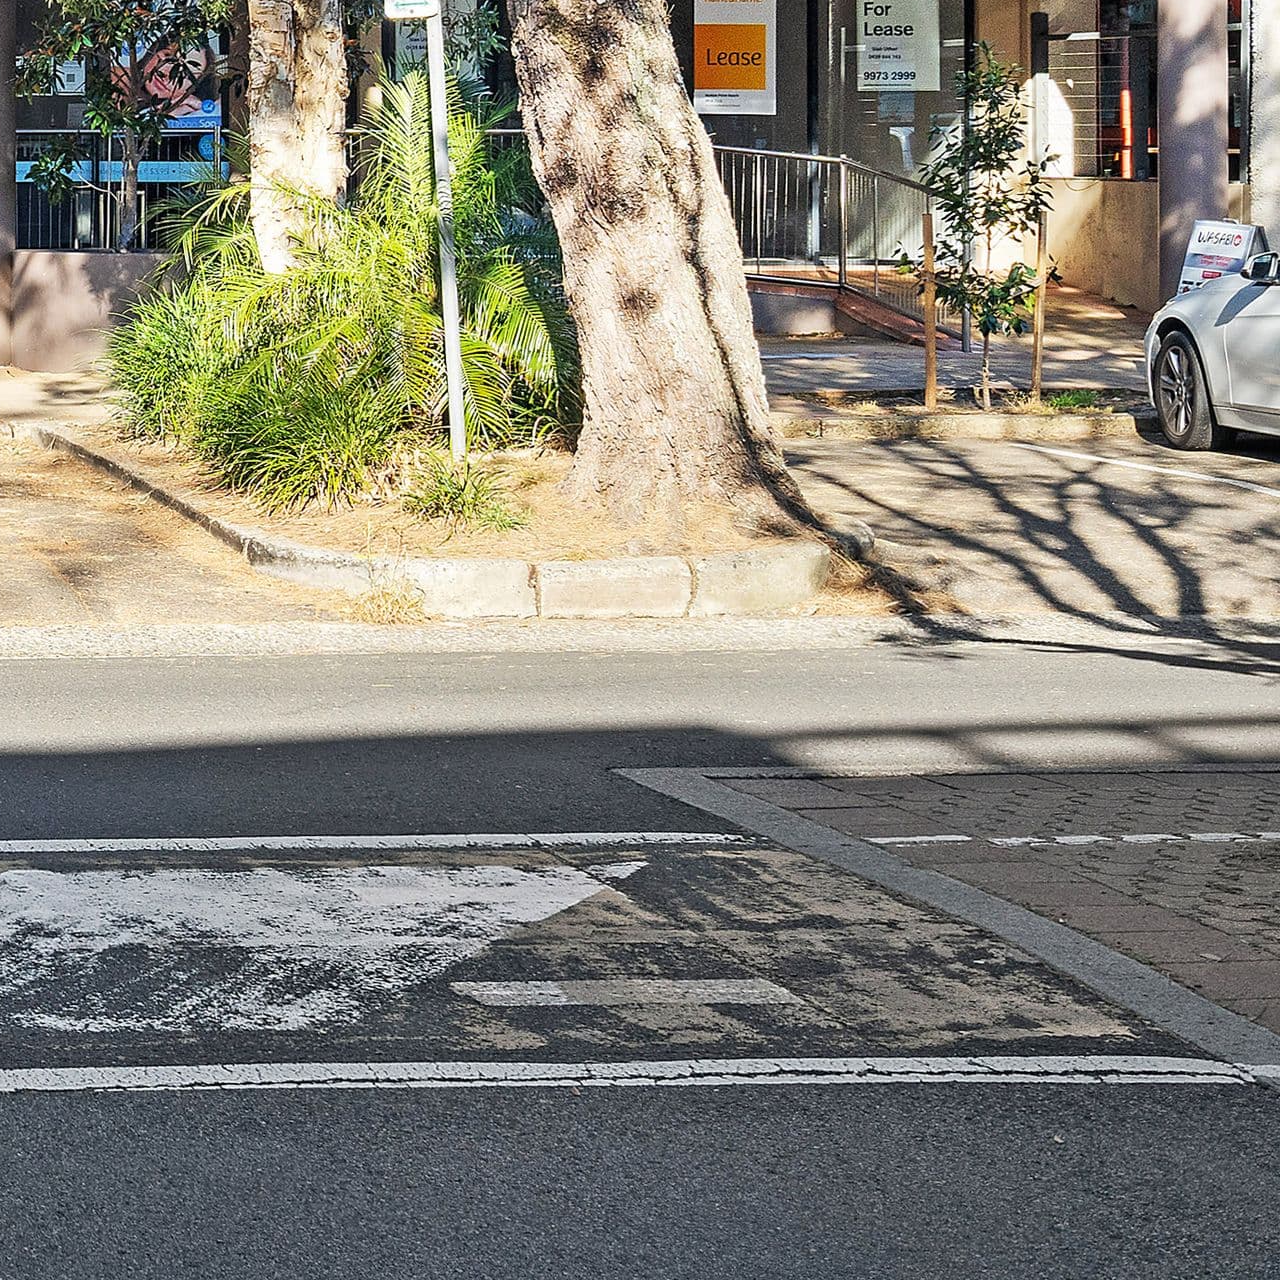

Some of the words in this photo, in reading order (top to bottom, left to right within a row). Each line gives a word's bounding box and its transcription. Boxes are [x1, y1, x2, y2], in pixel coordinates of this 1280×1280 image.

[864, 1, 892, 16] For
[864, 22, 914, 36] Lease
[706, 48, 762, 66] Lease
[863, 71, 889, 80] 9973
[891, 71, 917, 80] 2999
